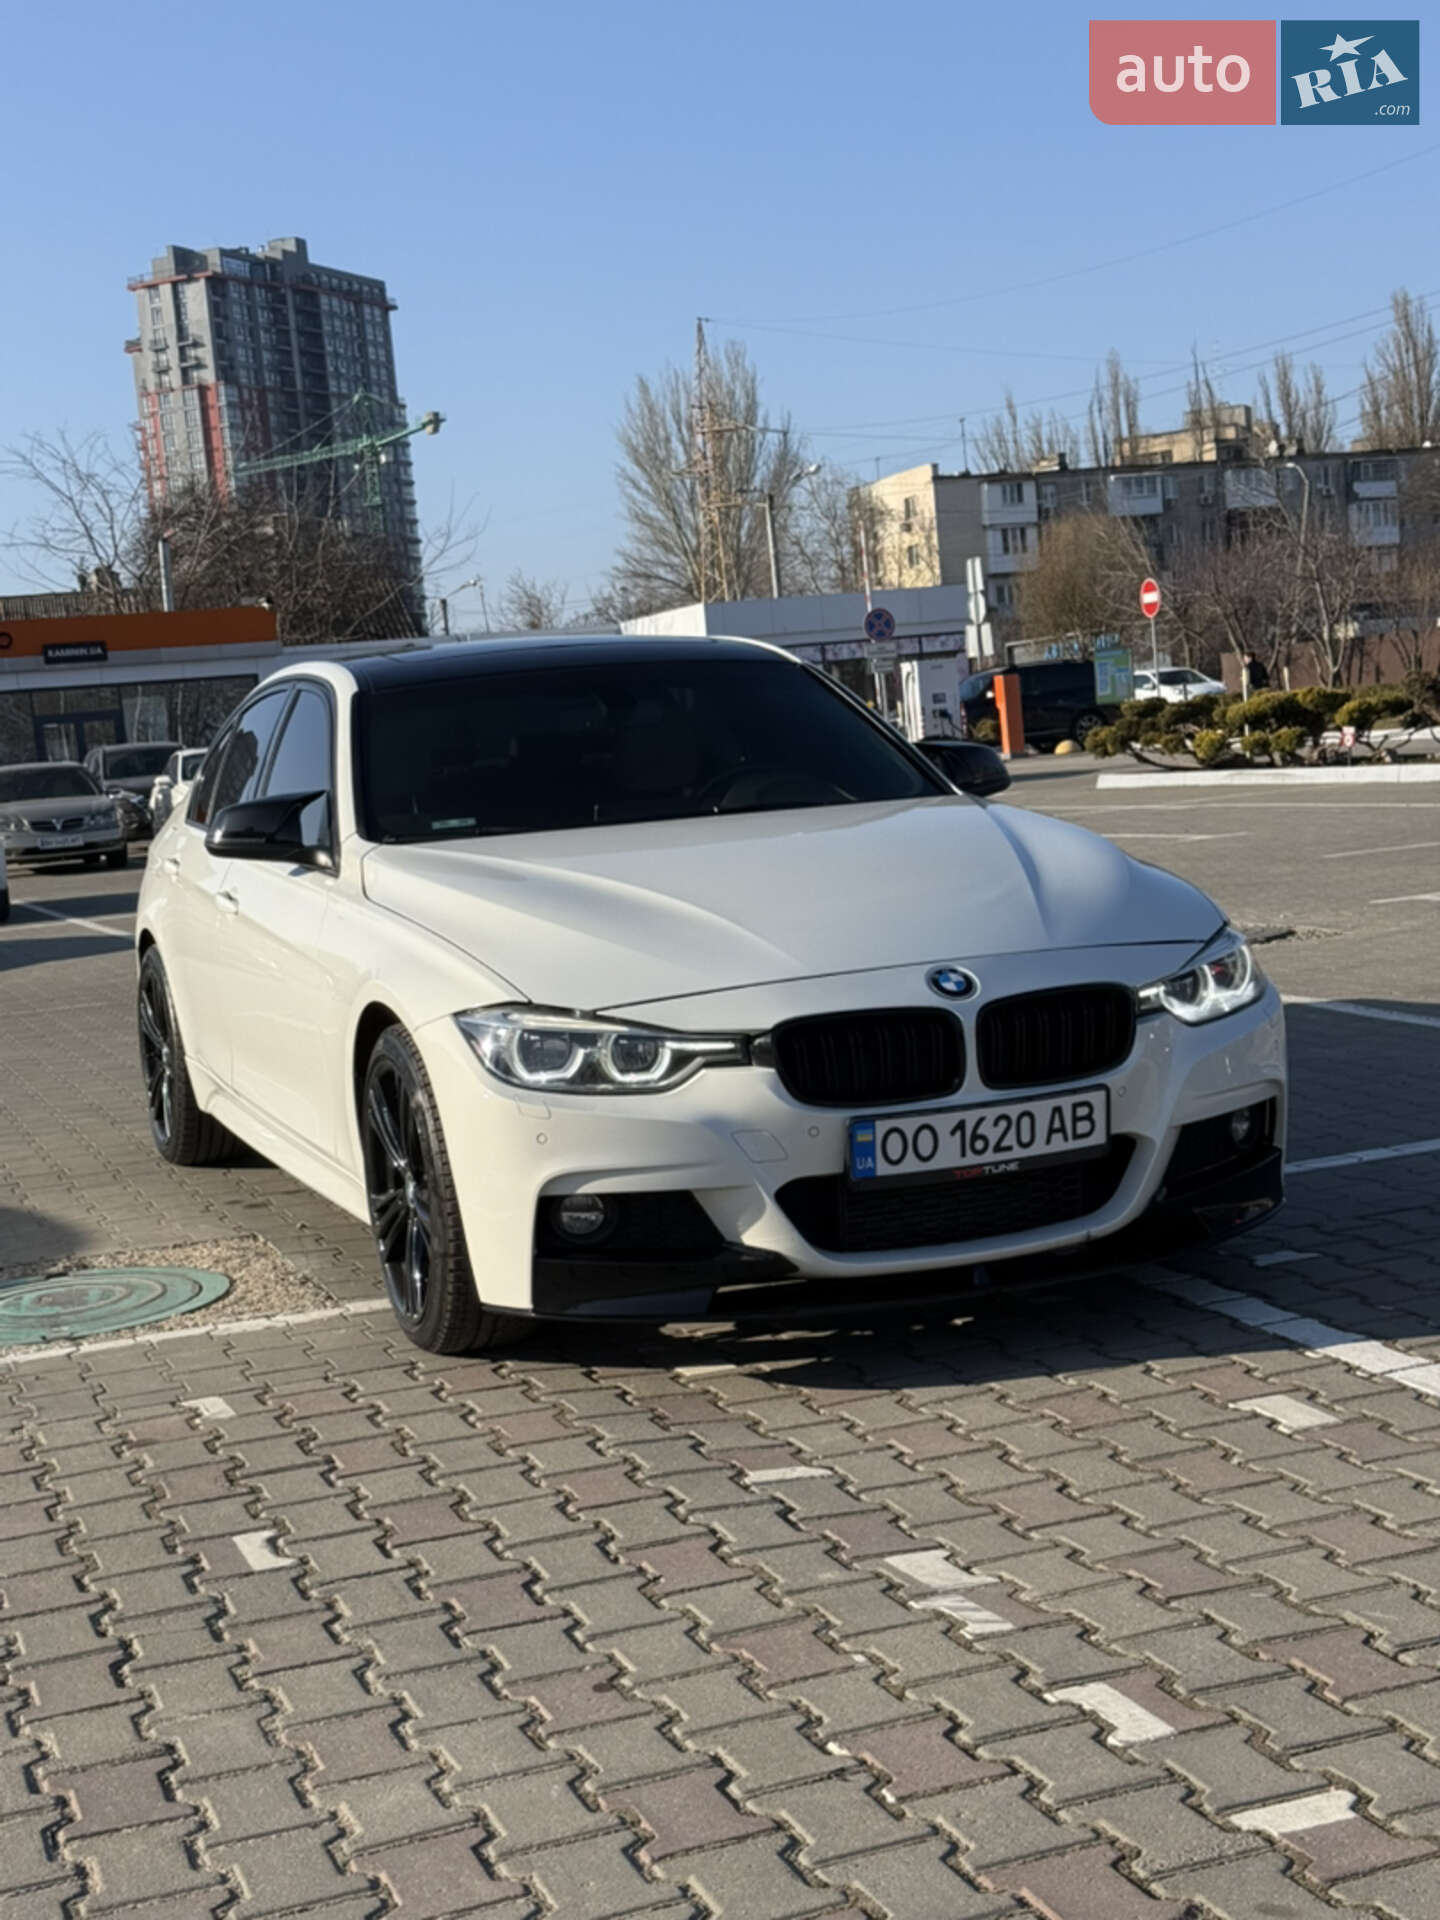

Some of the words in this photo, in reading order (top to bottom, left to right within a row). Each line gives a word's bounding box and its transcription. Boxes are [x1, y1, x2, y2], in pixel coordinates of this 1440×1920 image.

[881, 1123, 939, 1166] OO
[949, 1110, 1037, 1158] 1620
[1045, 1100, 1096, 1146] AB
[856, 1156, 874, 1170] UA
